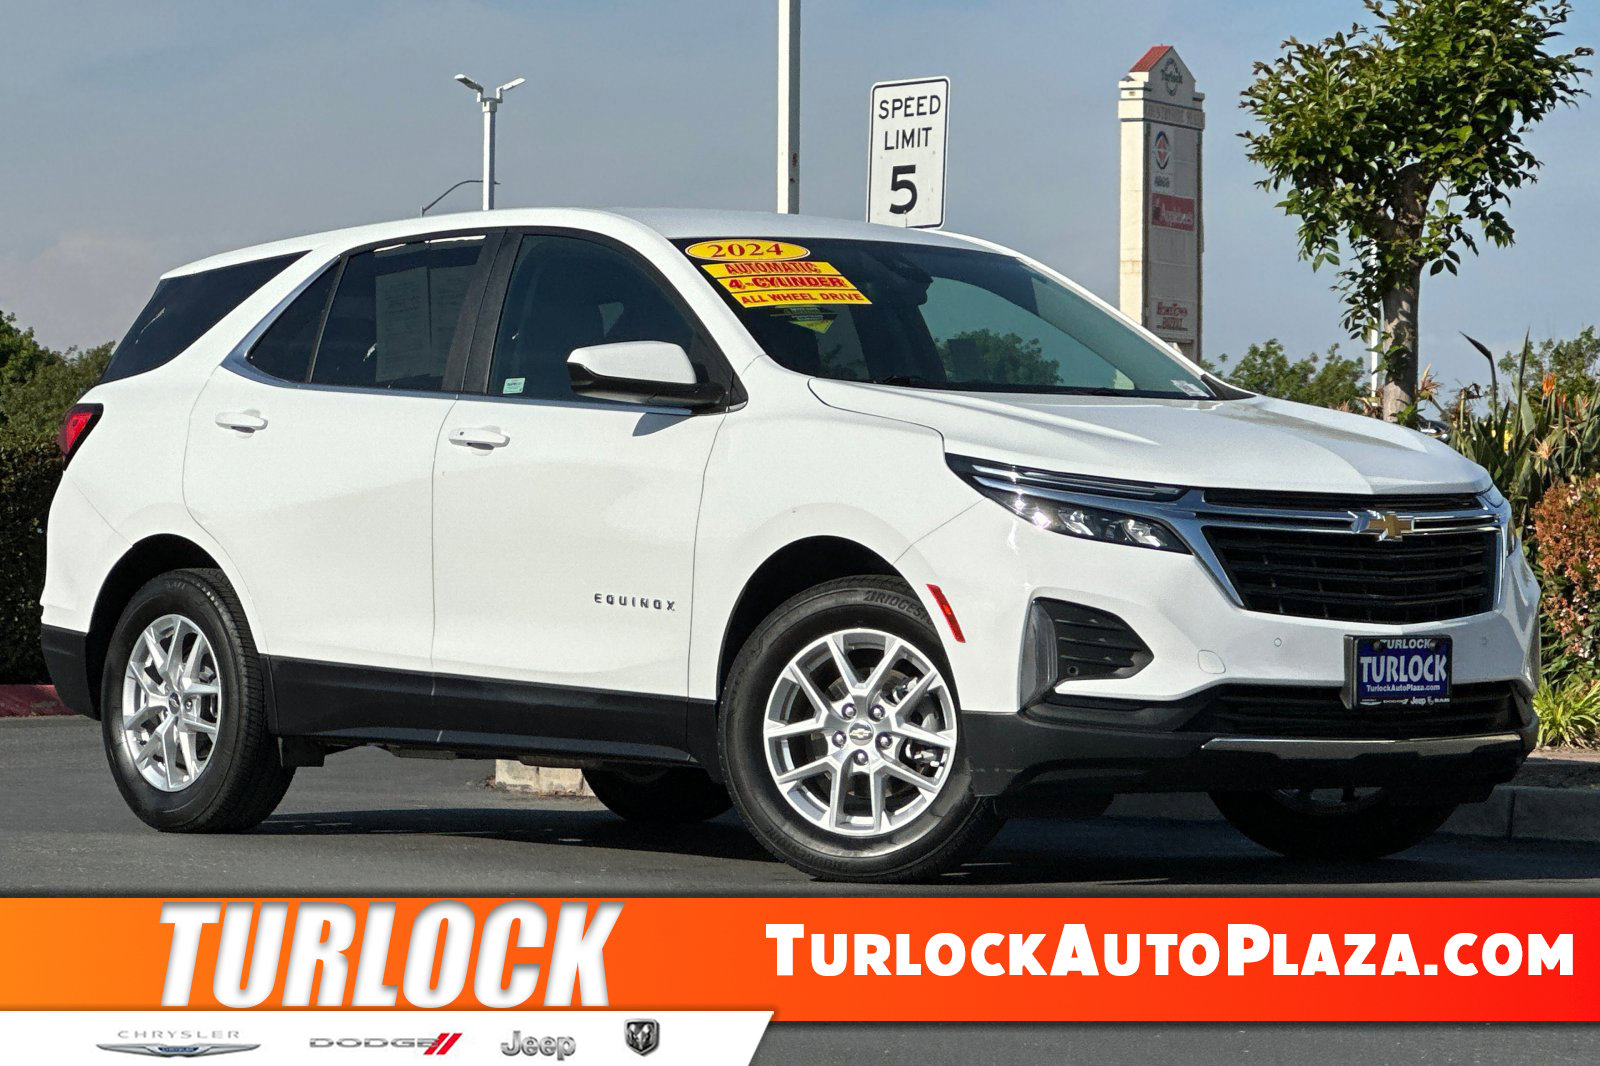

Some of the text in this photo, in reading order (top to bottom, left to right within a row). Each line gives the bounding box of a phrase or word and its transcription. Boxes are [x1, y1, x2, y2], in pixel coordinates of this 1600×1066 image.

[878, 95, 941, 119] SPEED
[884, 127, 932, 150] LIMIT
[889, 164, 918, 215] 5
[707, 243, 783, 258] 2024
[725, 262, 822, 275] AUTOMATIC
[728, 277, 846, 290] 4-CYLINDER
[741, 293, 864, 305] ALL WHEEL DRIVE
[594, 593, 675, 611] EQUINOX
[1360, 654, 1447, 683] TURLOCK
[1366, 684, 1440, 692] TurlockAutoPlaza.com
